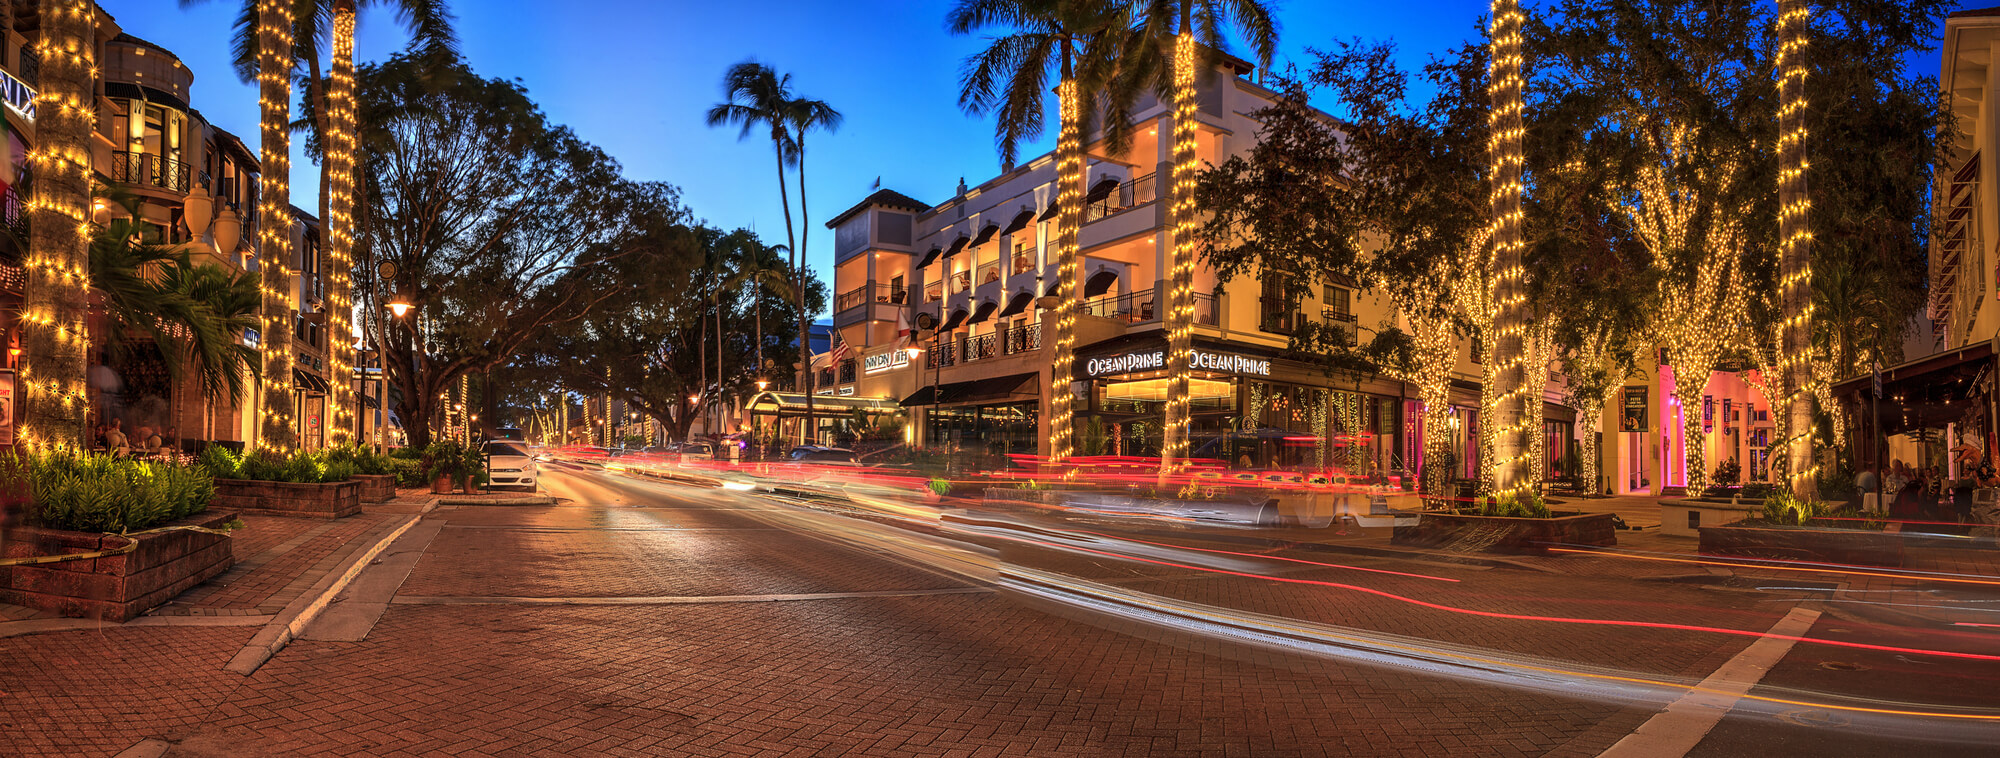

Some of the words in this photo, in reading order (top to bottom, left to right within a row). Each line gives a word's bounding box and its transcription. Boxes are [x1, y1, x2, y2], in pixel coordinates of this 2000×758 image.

[1088, 356, 1127, 376] OCEAN
[1127, 352, 1163, 372] PRIME
[1188, 349, 1234, 371] OCEAN
[1234, 354, 1271, 376] PRIME
